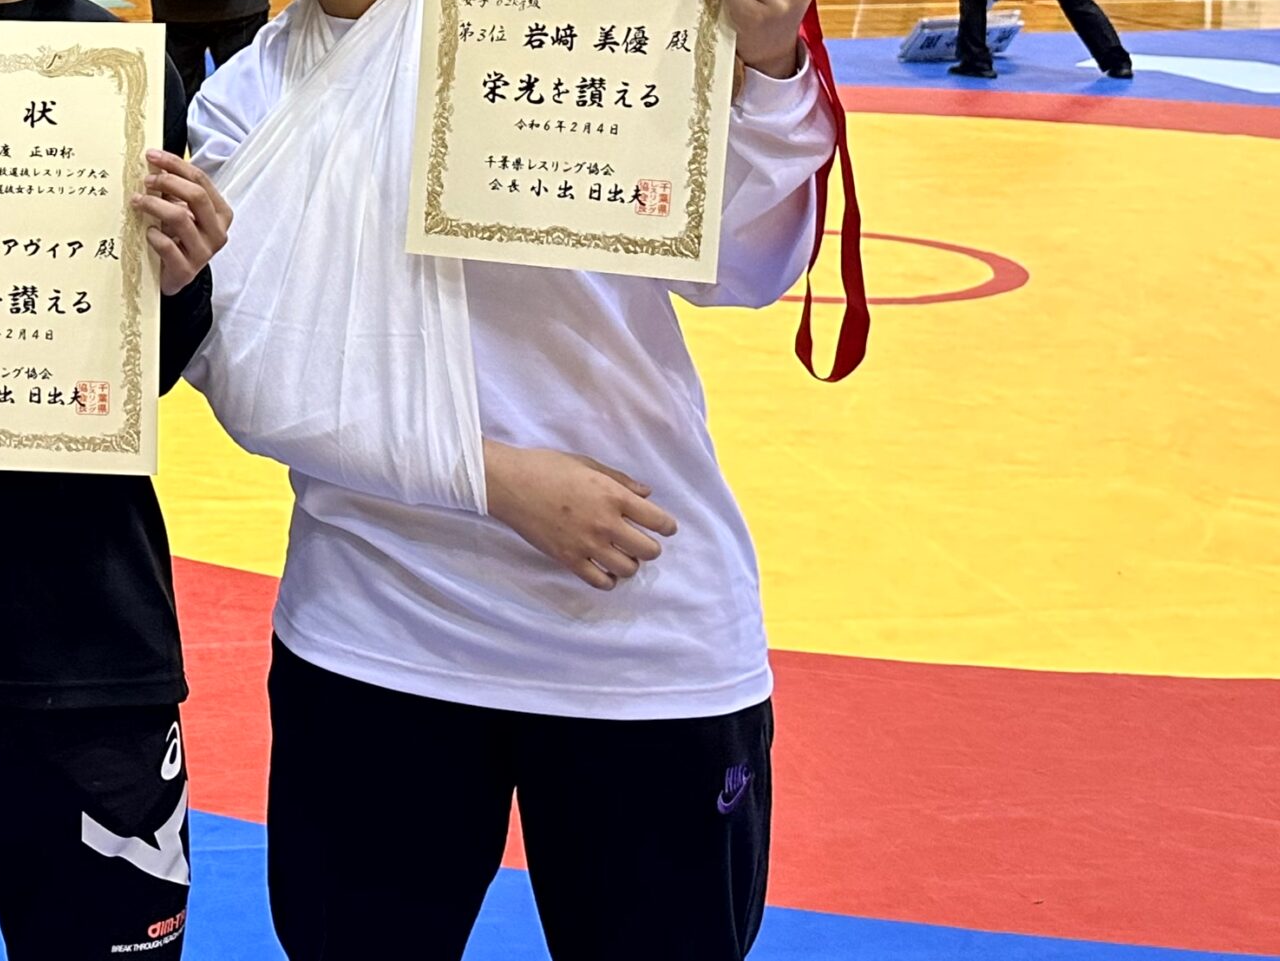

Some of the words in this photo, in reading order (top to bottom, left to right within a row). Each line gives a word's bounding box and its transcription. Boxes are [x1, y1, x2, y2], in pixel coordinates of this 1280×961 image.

[458, 21, 507, 42] 第3位
[514, 118, 620, 136] 令和6年2月4日
[29, 146, 76, 160] 正田杯
[484, 155, 616, 177] 千葉県レスリング協会
